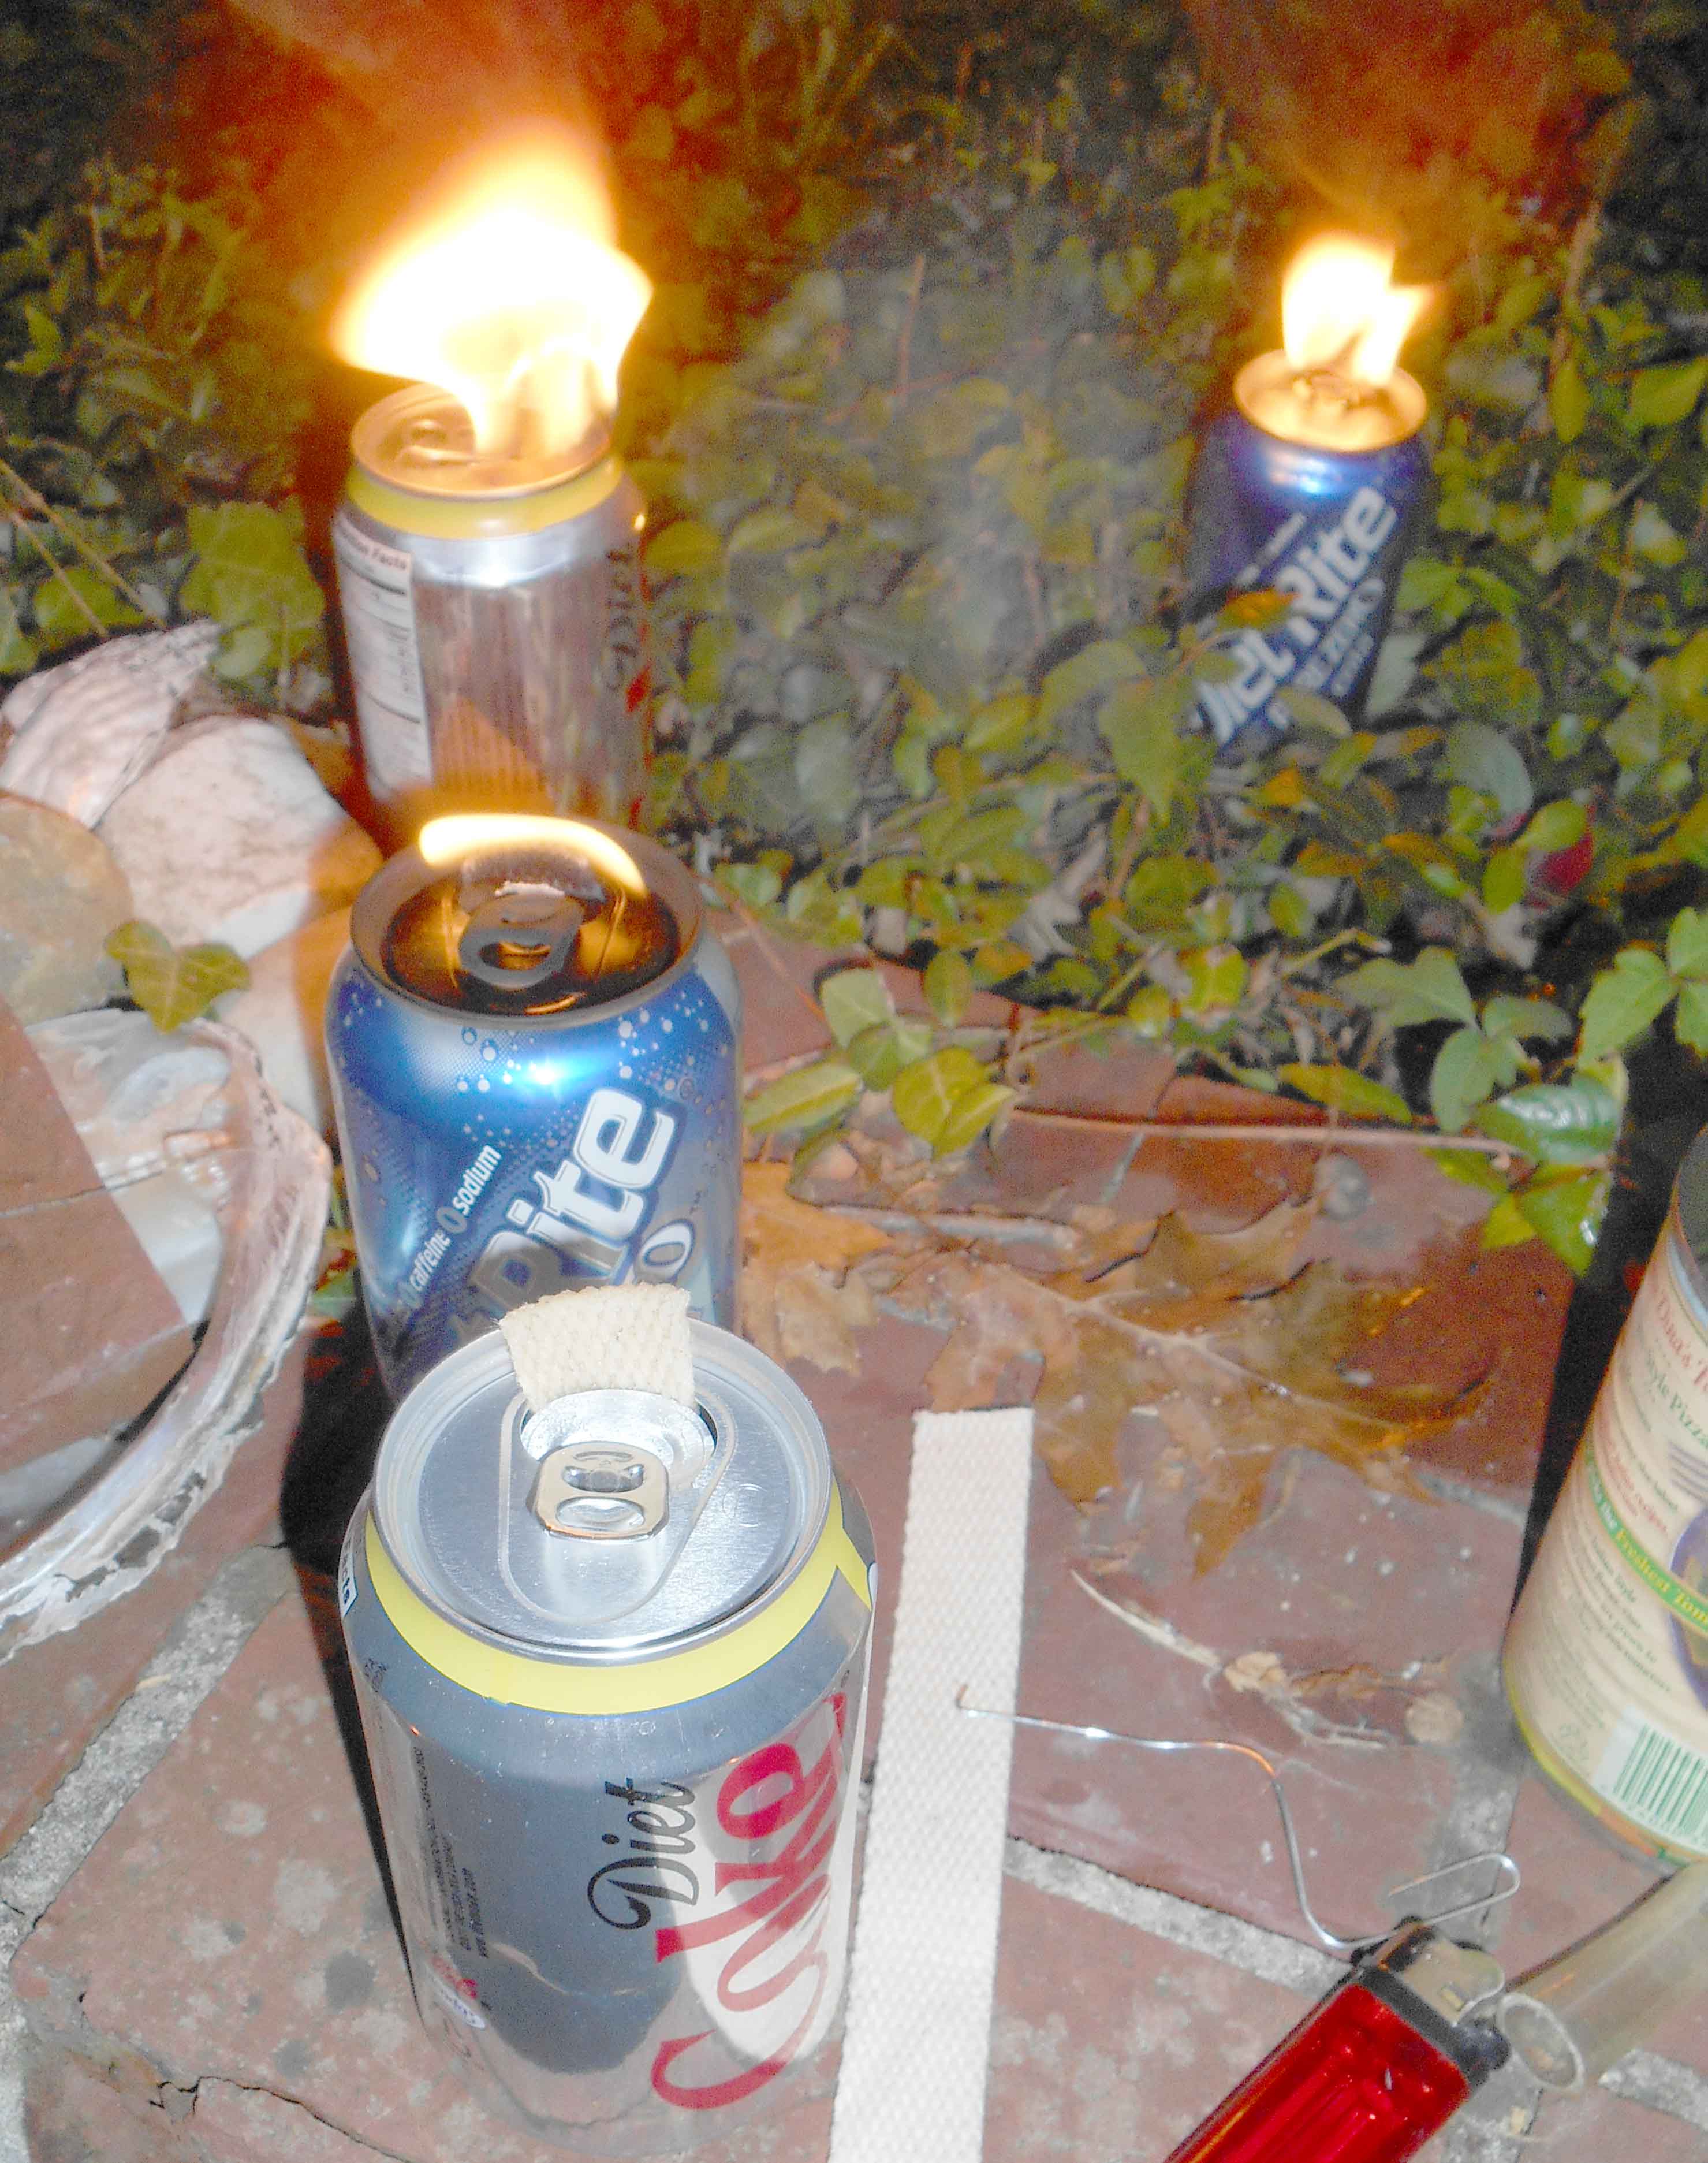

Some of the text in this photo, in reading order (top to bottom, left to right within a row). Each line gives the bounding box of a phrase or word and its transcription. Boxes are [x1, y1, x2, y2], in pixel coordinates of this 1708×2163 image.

[409, 1228, 452, 1294] caffeine
[452, 1145, 501, 1216] sodium
[587, 1777, 698, 1930] Diet
[650, 1692, 846, 2109] Coke
